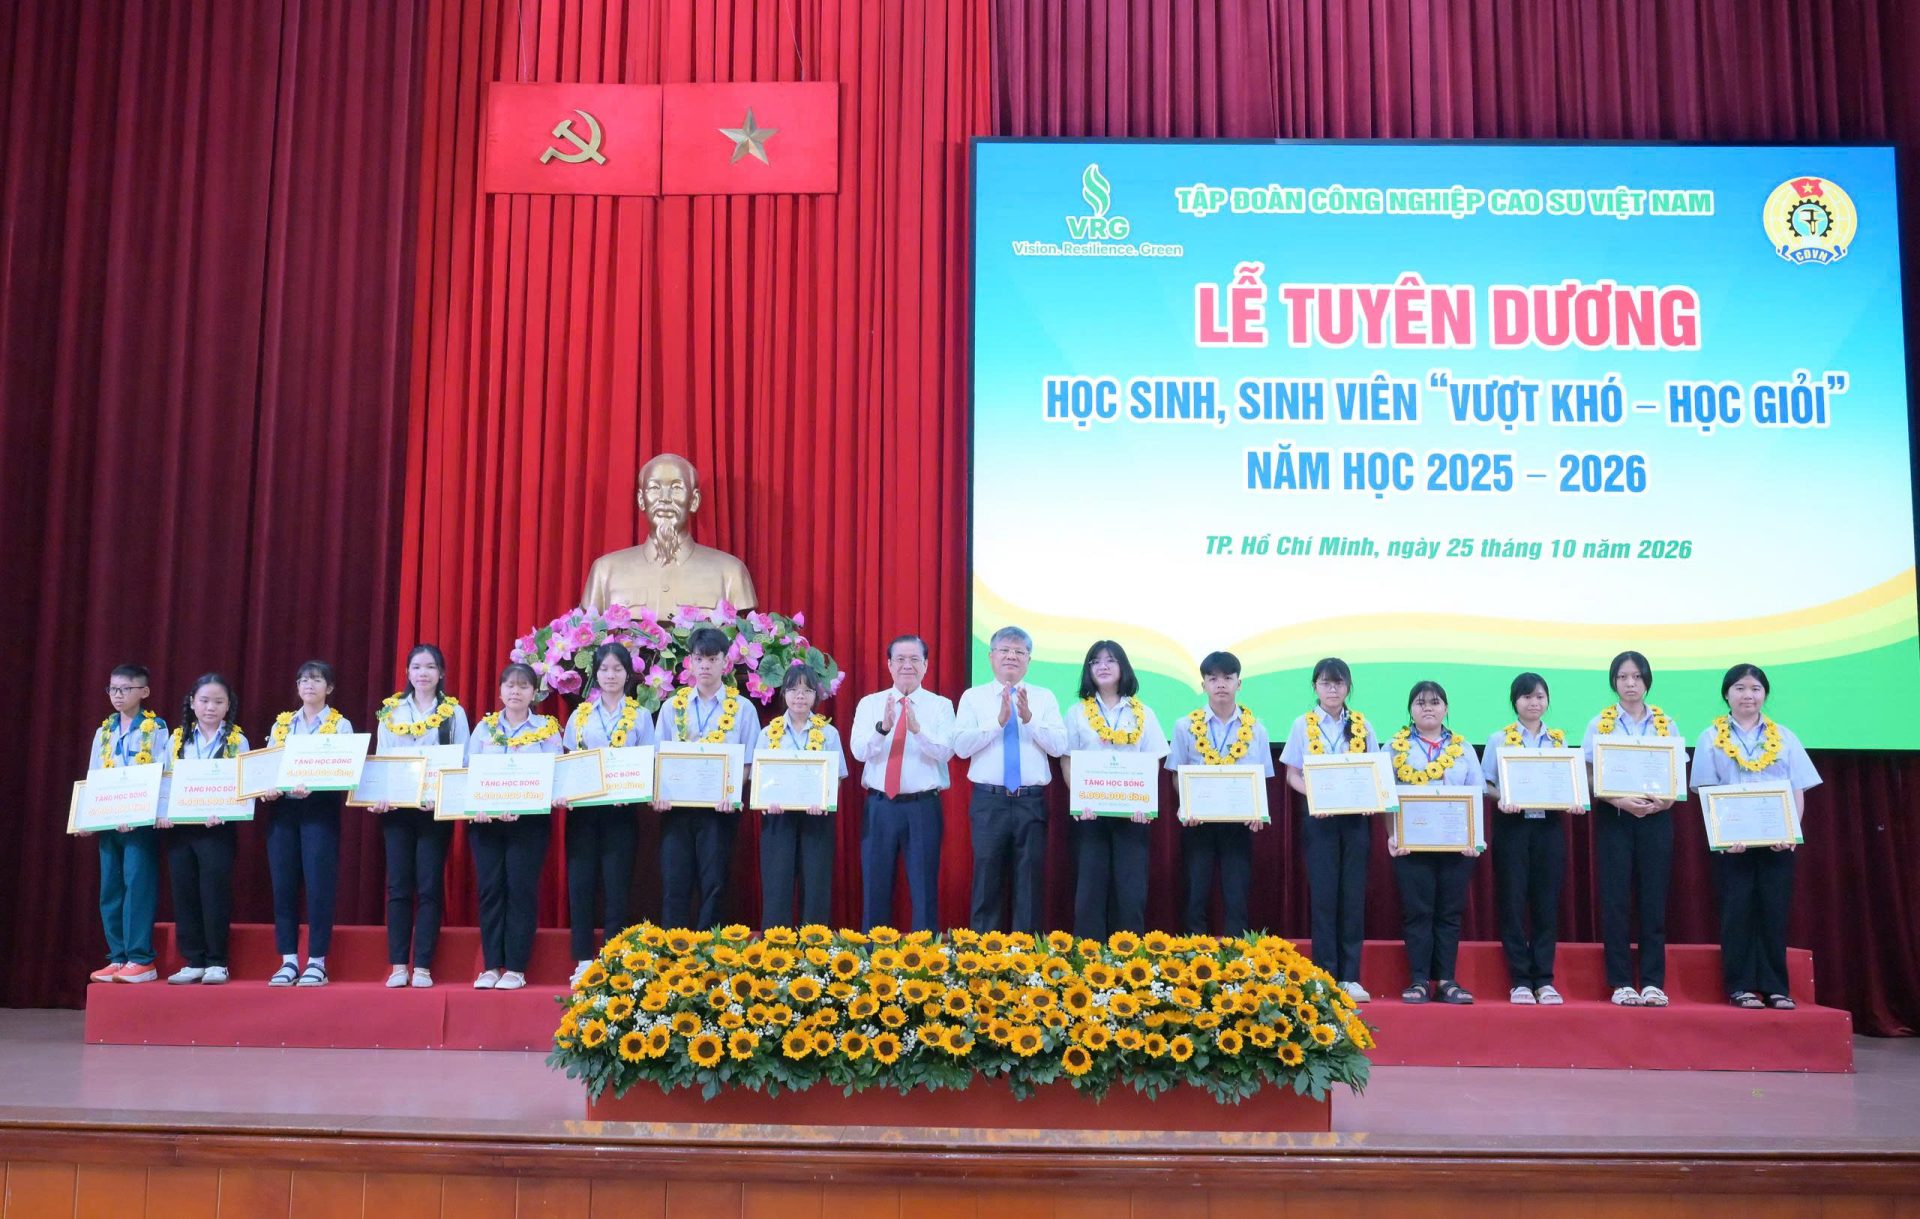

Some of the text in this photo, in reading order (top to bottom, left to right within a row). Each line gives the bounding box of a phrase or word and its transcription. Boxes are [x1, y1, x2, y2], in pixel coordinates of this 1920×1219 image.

[1177, 186, 1712, 217] TẬP ĐOÀN CÔNG NGHIỆP CAO SU VIỆT NAM
[1067, 217, 1129, 239] VRG
[1013, 242, 1183, 257] Vision. Resilience. Green
[1199, 266, 1697, 347] LỄ TUYÊN DƯƠNG
[1046, 380, 1118, 427] HỌC
[1130, 381, 1227, 424] SINH,
[1238, 382, 1324, 421] SINH
[1335, 374, 1418, 421] VIÊN
[1430, 372, 1539, 431] “VƯỢT
[1551, 376, 1623, 424] KHÓ
[1669, 384, 1741, 432] HỌC
[1753, 372, 1846, 425] GIỎI”
[1247, 443, 1330, 490] NĂM
[1343, 452, 1415, 499] HỌC
[1426, 453, 1514, 492] 2025
[1559, 454, 1648, 493] 2026
[1205, 533, 1694, 561] TP. Hồ Chí Minh, ngày 25 tháng 10 năm 2026
